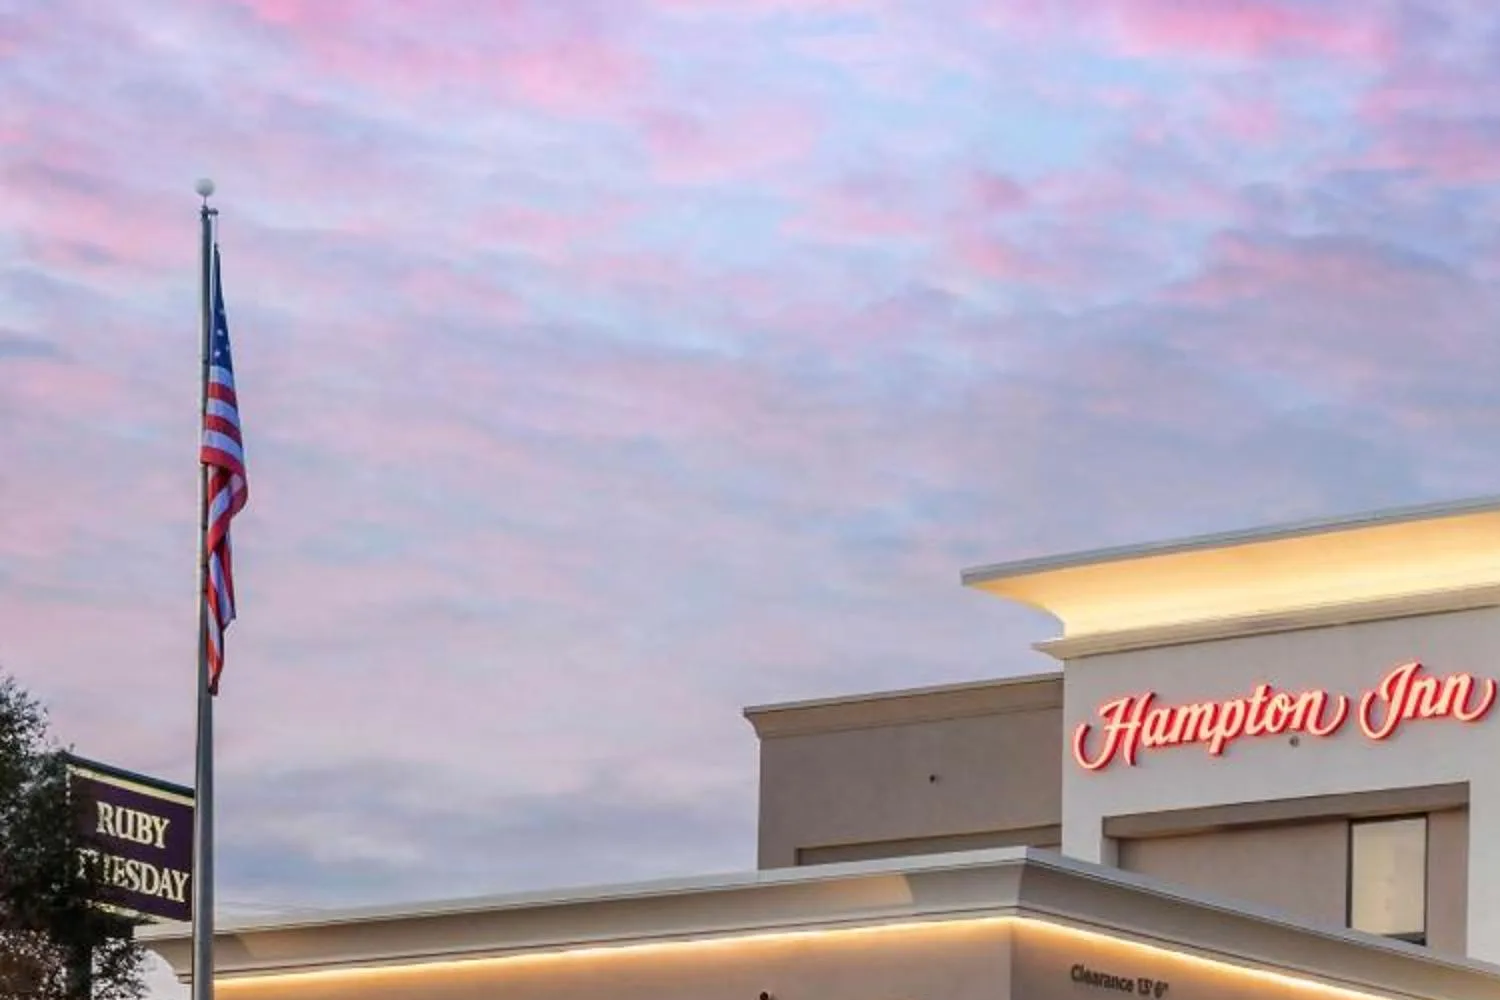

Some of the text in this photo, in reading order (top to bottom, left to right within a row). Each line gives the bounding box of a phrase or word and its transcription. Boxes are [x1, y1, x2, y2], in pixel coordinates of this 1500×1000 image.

[1073, 660, 1498, 770] Hampton Inn
[96, 800, 171, 849] RUBY
[1071, 963, 1134, 993] Clearance
